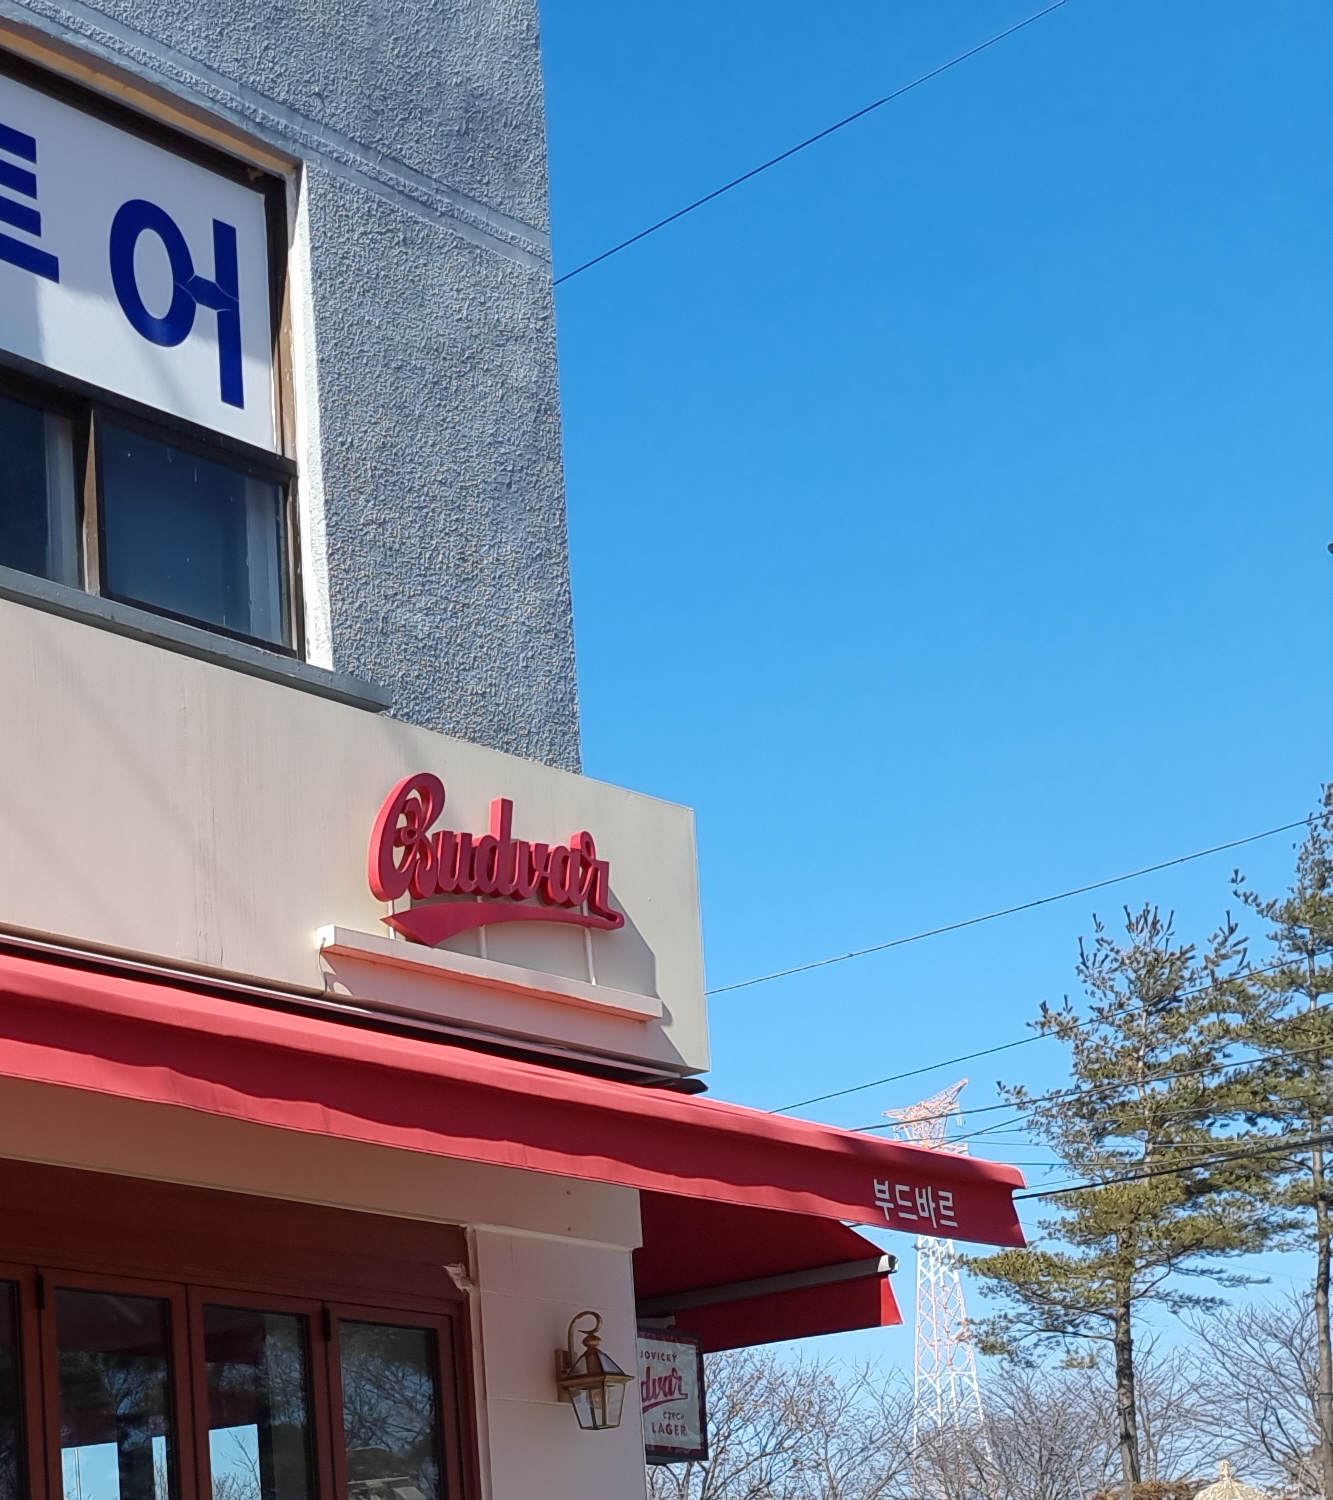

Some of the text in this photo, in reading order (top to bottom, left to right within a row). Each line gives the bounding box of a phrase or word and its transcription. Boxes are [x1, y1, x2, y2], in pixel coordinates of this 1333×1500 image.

[368, 772, 625, 932] Budvar
[873, 1178, 959, 1229] 부드바르
[651, 1421, 687, 1437] LAGER
